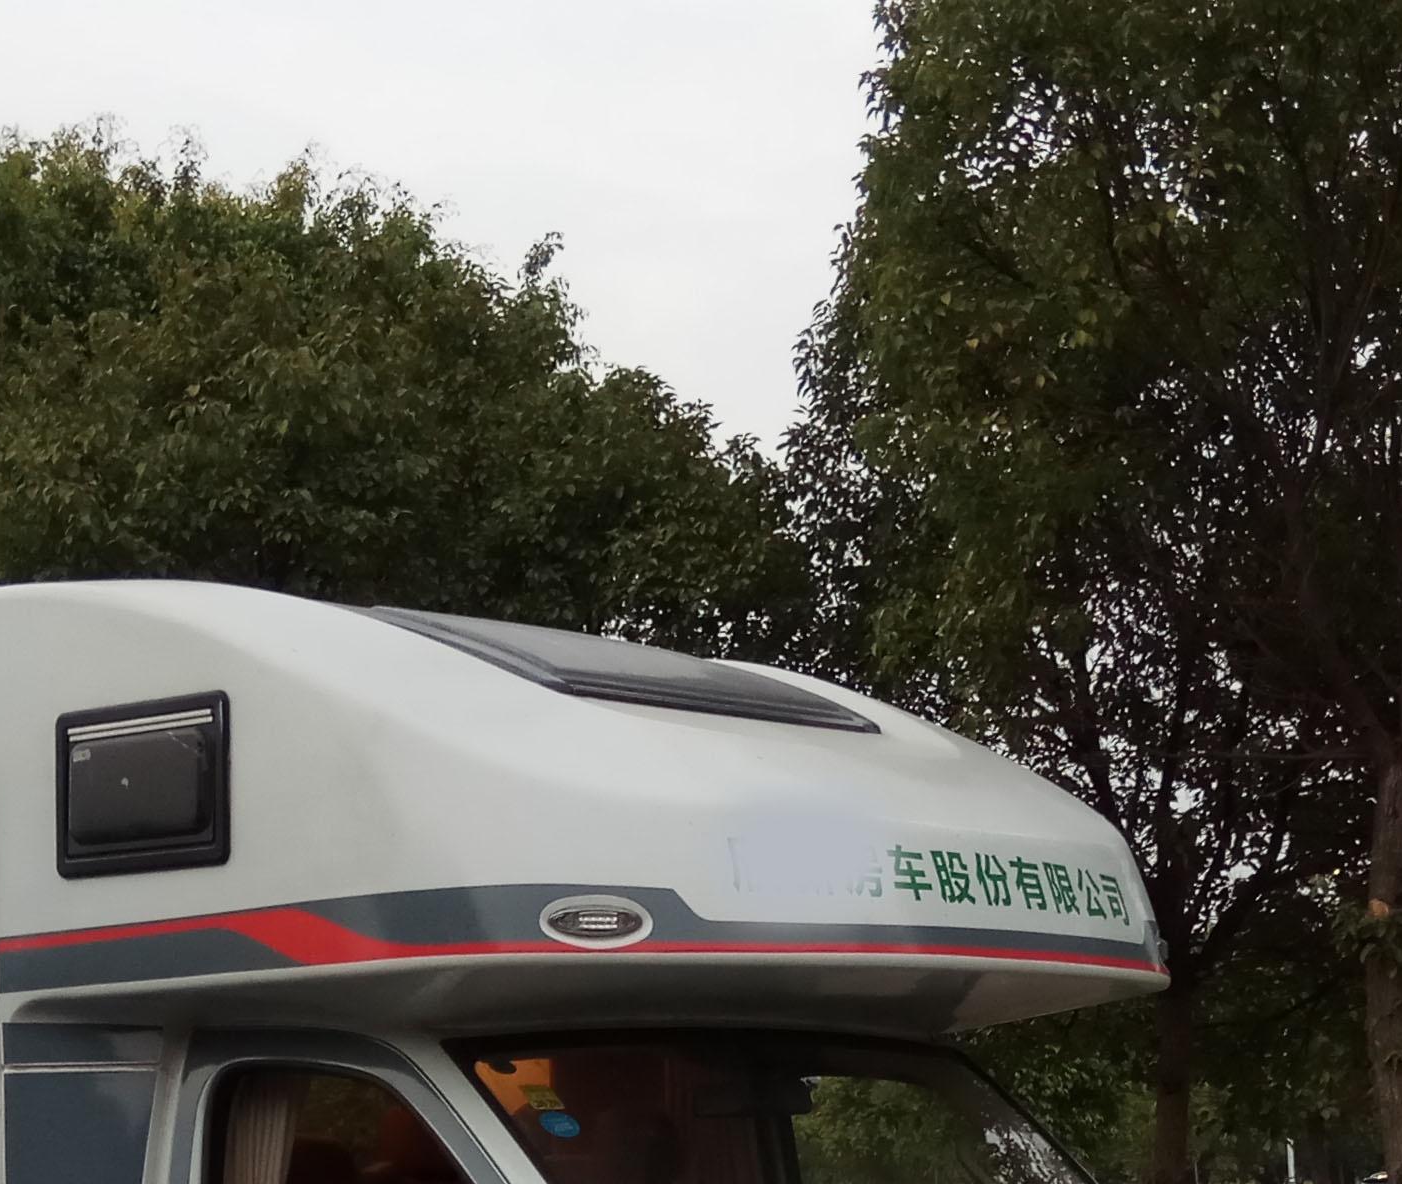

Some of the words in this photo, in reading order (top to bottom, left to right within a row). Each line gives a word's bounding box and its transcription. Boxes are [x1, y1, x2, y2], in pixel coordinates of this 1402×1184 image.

[726, 836, 1130, 926] 房车股份有限公司
